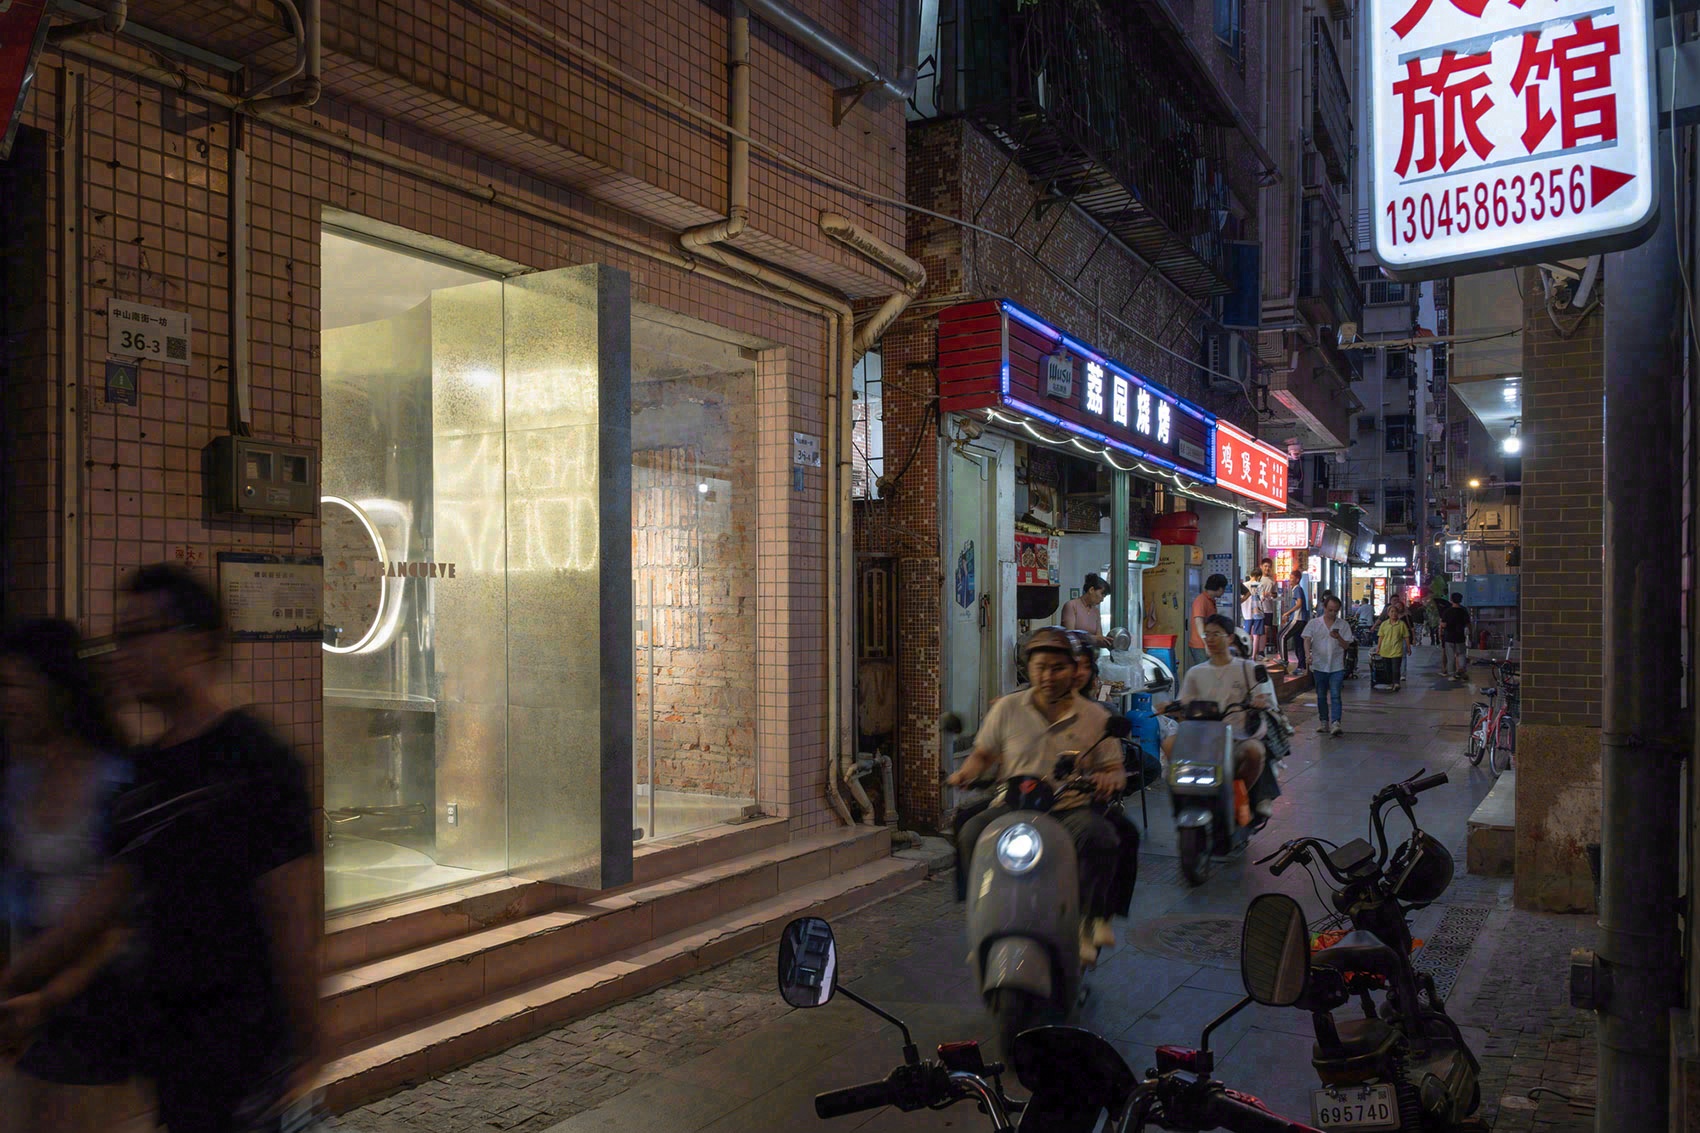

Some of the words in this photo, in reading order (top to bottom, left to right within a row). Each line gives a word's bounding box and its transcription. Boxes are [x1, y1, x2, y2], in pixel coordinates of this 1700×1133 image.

[1393, 16, 1621, 178] 旅馆
[1386, 164, 1586, 246] 13045863356
[121, 330, 160, 353] 36-3
[1220, 442, 1269, 489] 鸡煲王
[1320, 1103, 1389, 1124] 69574D
